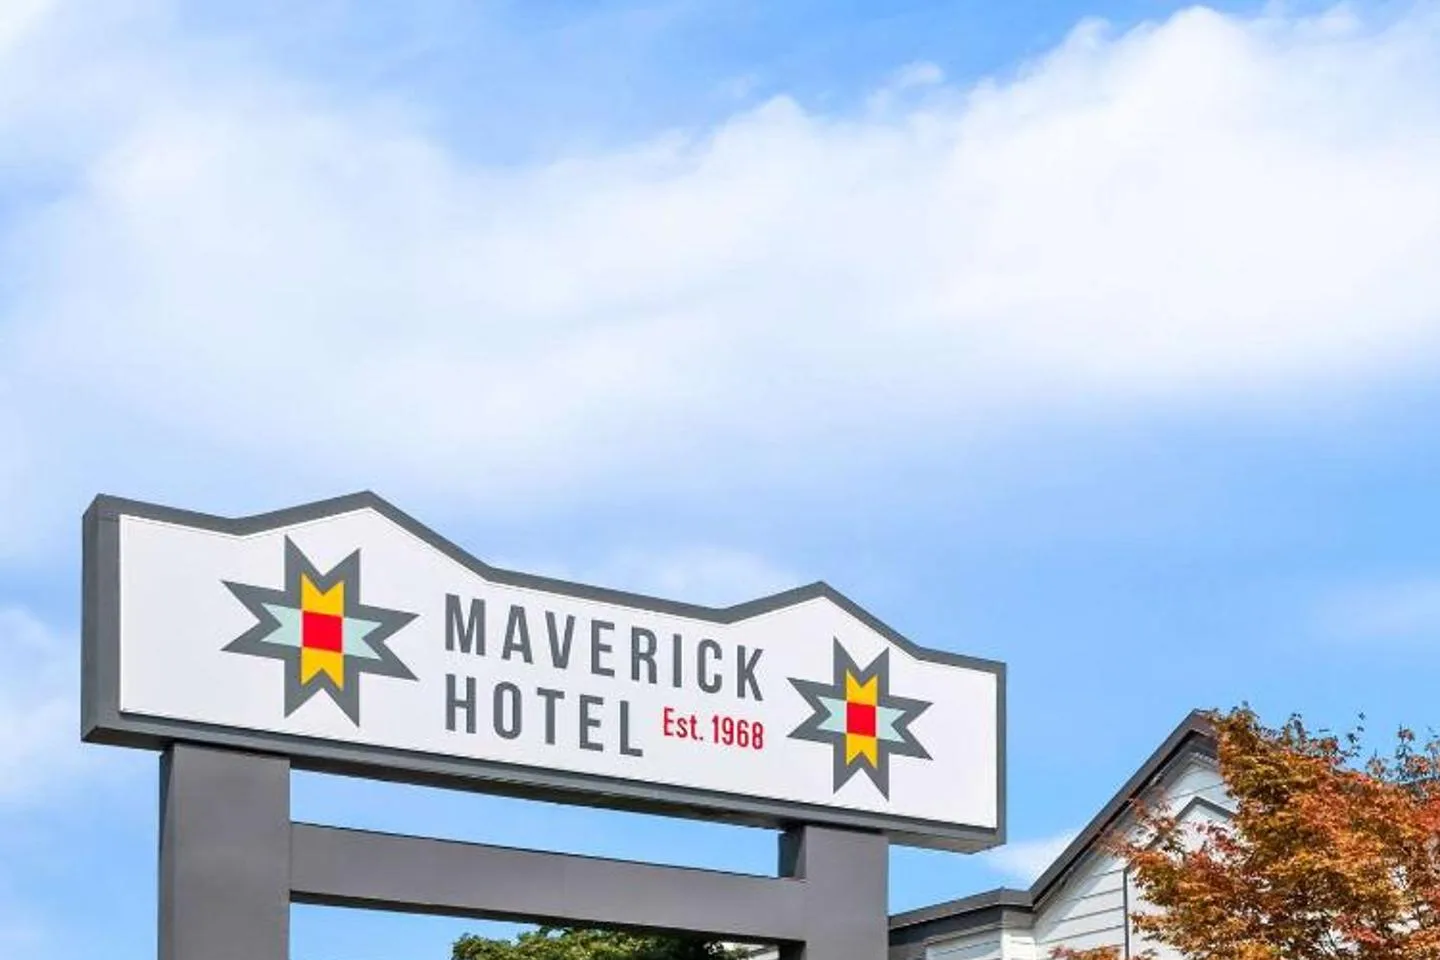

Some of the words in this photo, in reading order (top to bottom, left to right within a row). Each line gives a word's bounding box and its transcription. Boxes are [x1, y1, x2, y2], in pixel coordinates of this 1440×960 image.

[446, 593, 764, 700] MAVERICK
[446, 674, 643, 756] HOTEL
[662, 706, 704, 741] Est.
[711, 714, 764, 749] 1968
